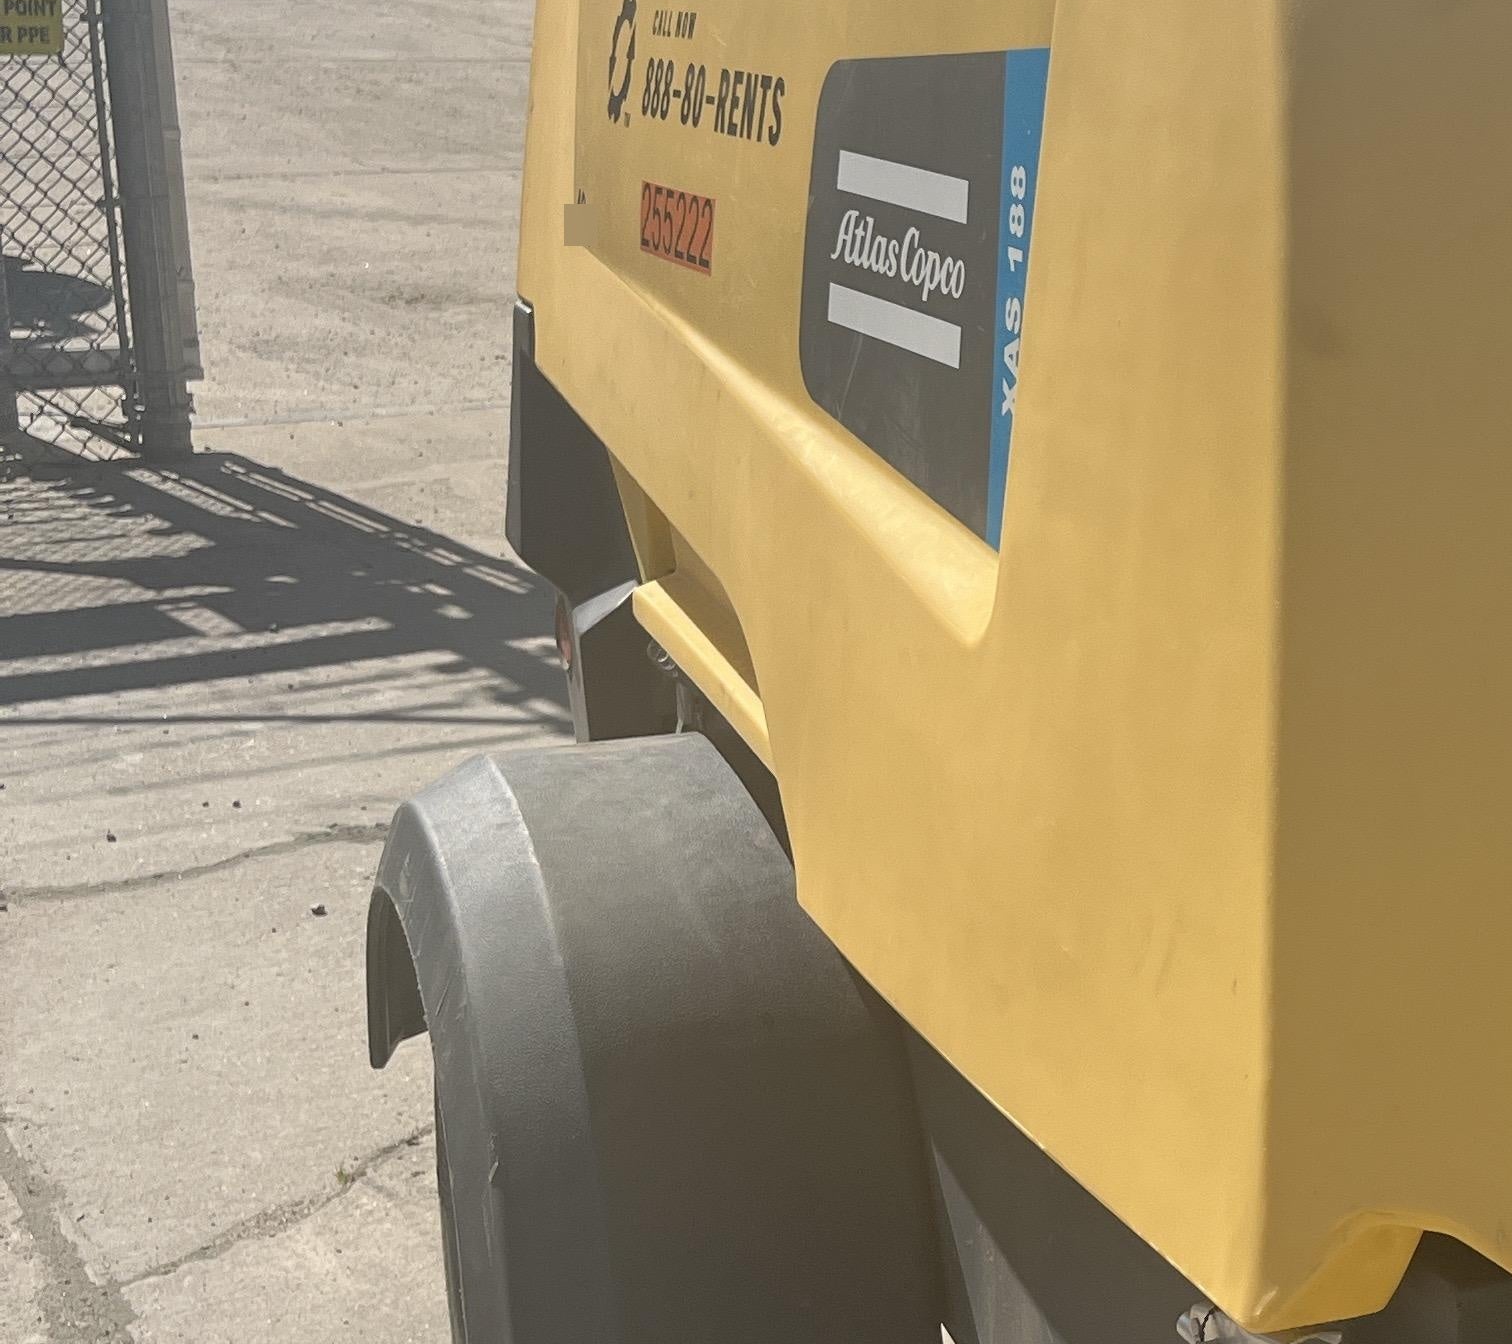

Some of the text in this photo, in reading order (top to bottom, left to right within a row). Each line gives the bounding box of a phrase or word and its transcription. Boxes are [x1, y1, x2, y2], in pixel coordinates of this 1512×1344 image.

[4, 0, 57, 17] POINT
[17, 26, 49, 44] PPE
[652, 10, 697, 39] CALL NOW
[641, 56, 786, 147] 888-80-RENTS
[640, 182, 713, 268] 255222
[830, 210, 965, 302] Atlas Copco
[1001, 165, 1026, 417] XAS 188
